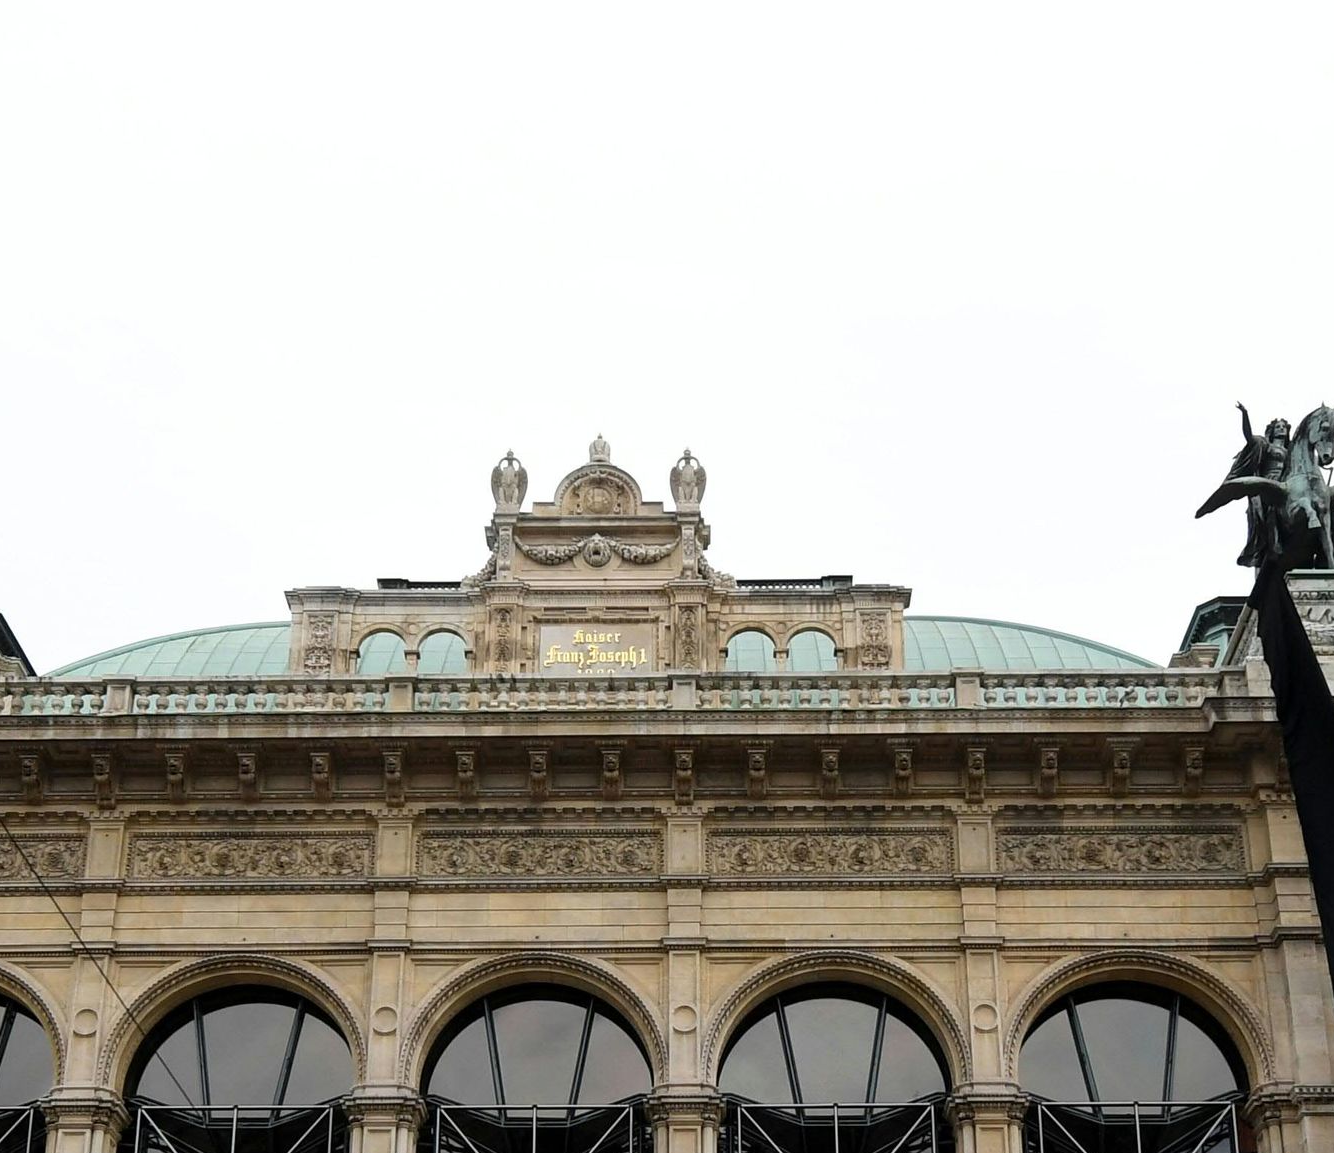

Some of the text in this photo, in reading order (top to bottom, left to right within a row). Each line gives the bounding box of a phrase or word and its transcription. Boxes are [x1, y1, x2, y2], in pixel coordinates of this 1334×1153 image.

[572, 629, 621, 645] Kaiser
[543, 644, 584, 668] Franz
[586, 644, 637, 669] Joseph
